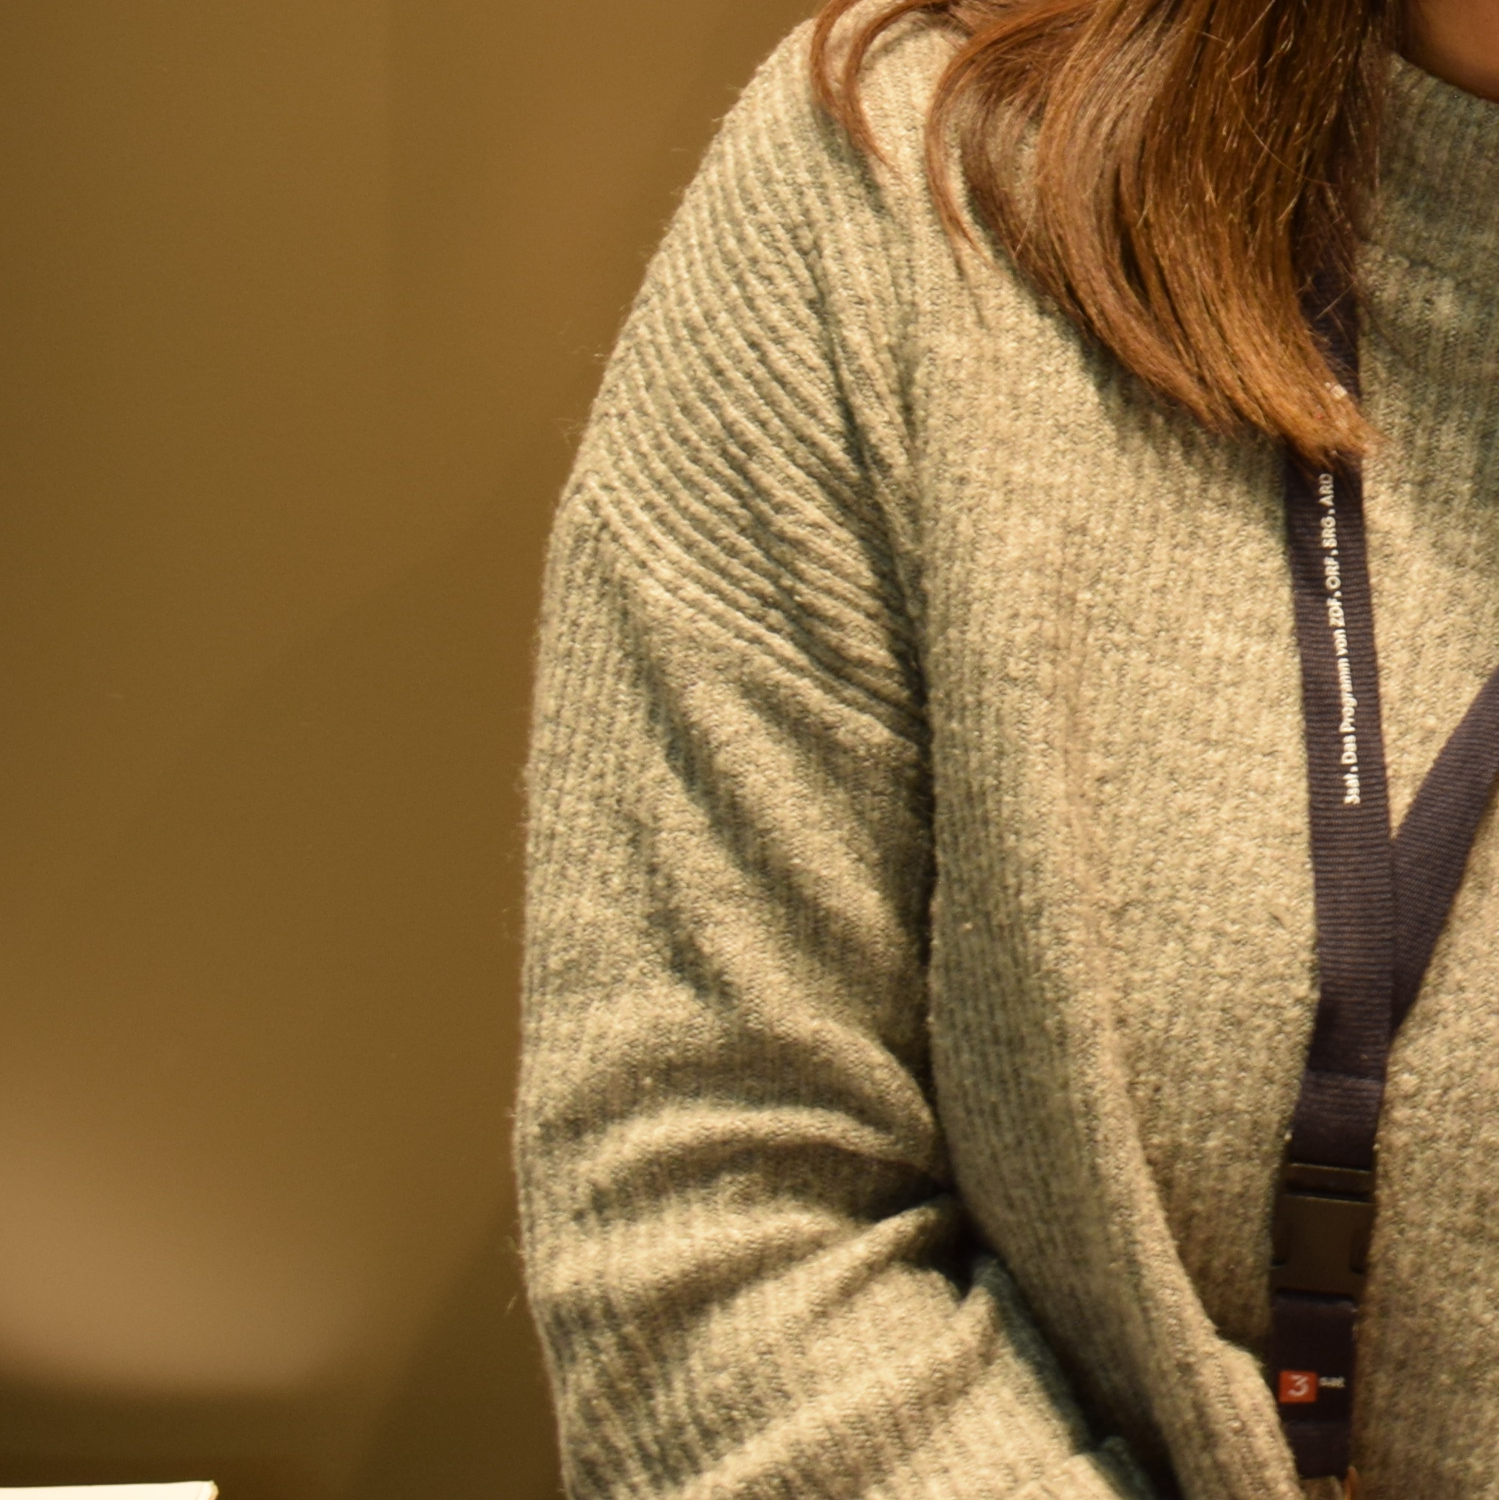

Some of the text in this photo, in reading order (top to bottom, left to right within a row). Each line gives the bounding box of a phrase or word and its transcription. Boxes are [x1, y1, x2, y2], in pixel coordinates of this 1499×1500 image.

[1335, 629, 1349, 656] von
[1338, 657, 1359, 732] Programm
[1341, 734, 1357, 764] Das
